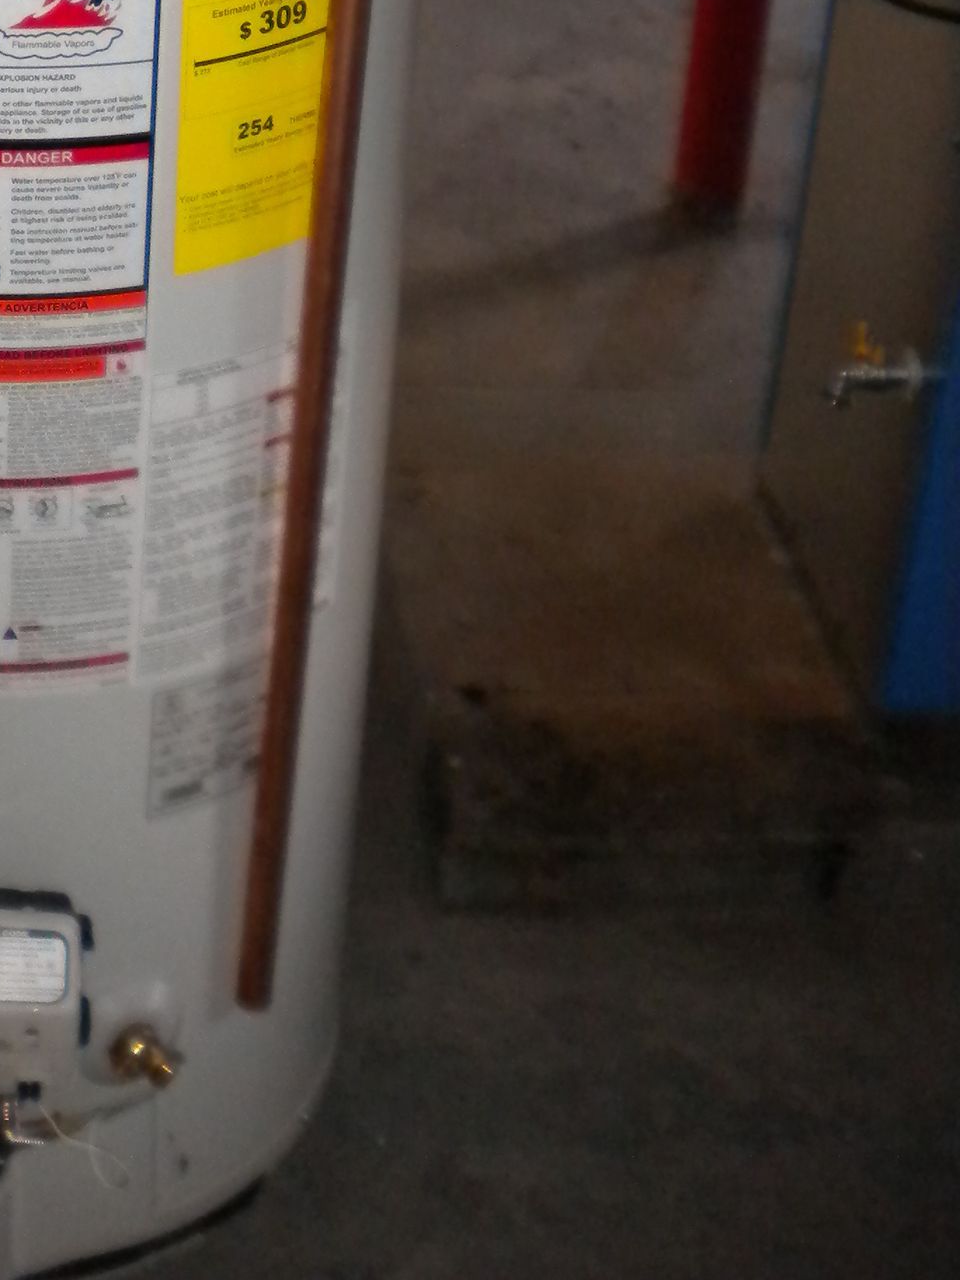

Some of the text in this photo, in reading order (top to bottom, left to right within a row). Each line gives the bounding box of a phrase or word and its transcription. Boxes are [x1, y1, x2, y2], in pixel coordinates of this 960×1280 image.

[212, 0, 256, 19] Estimated
[239, 0, 307, 41] $ 309
[12, 40, 95, 49] Flammable Vapors
[26, 86, 48, 95] injury
[237, 115, 274, 141] 254
[1, 151, 74, 164] DANGER
[35, 176, 82, 185] temperature
[11, 194, 32, 202] death
[5, 300, 89, 312] ADVERTENCIA
[22, 349, 71, 360] BEFORE
